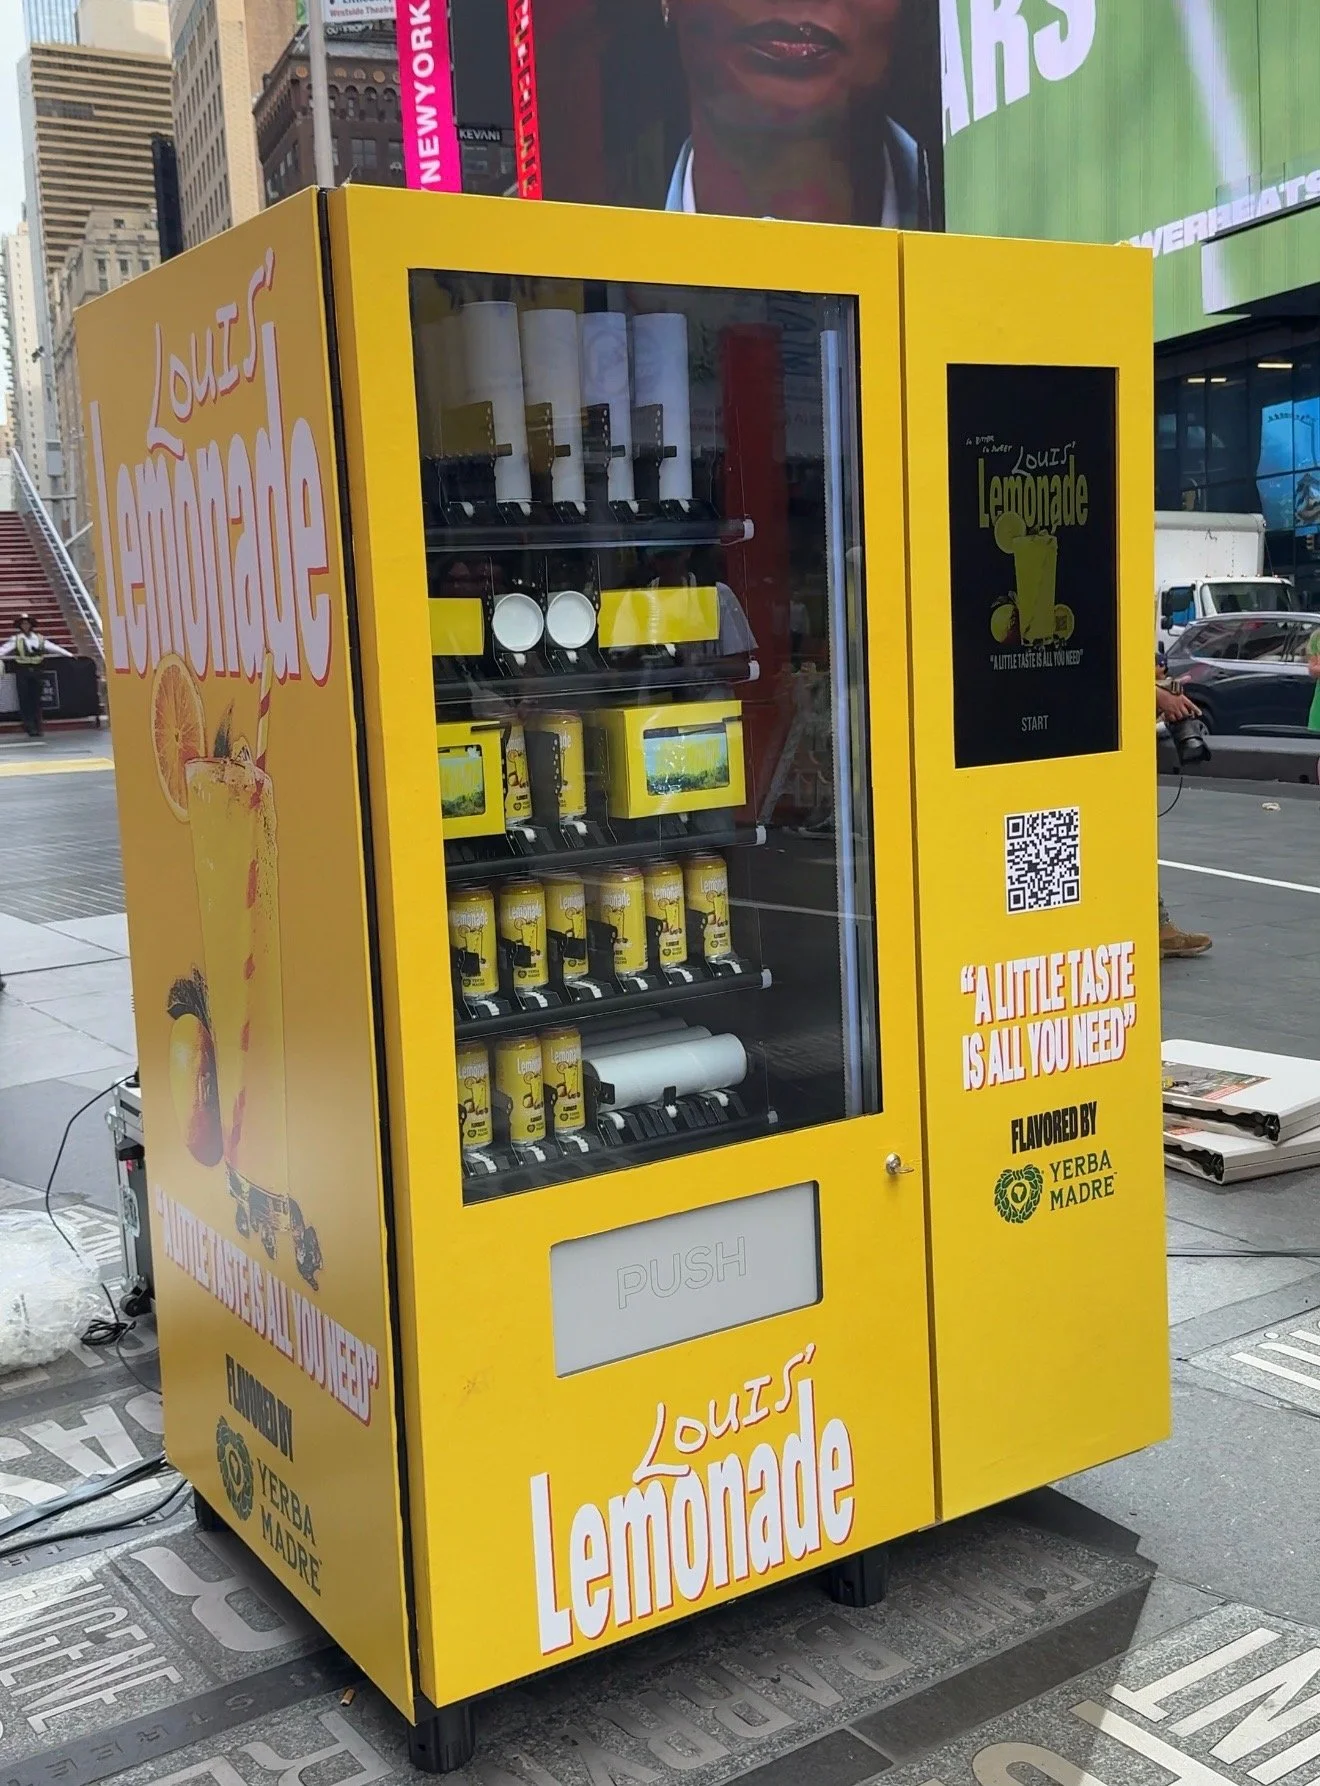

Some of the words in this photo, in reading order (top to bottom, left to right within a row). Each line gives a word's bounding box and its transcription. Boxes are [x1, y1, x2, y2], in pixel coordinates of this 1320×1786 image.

[90, 321, 332, 687] Lemonade
[977, 454, 1089, 529] Lemonade
[999, 653, 1018, 670] LITTLE
[1018, 651, 1036, 669] TASTE
[1036, 651, 1043, 668] IS
[1043, 650, 1053, 668] ALL
[1054, 650, 1066, 667] YOU
[1021, 715, 1049, 732] START
[994, 952, 1067, 1022] LITTLE
[1068, 940, 1136, 1008] TASTE
[962, 1032, 985, 1092] IS
[987, 1025, 1026, 1086] ALL
[1027, 1016, 1070, 1077] YOU
[1011, 1105, 1079, 1154] FLAVORED
[1079, 1100, 1098, 1139] BY
[1049, 1149, 1112, 1183] YERBA
[172, 1198, 211, 1293] LITTLE
[208, 1226, 251, 1328] TASTE
[250, 1257, 266, 1340] IS
[266, 1270, 294, 1363] ALL
[292, 1288, 327, 1389] YOU
[616, 1235, 747, 1310] PUSH
[225, 1352, 279, 1449] FLAVORED
[277, 1398, 294, 1463] BY
[257, 1457, 316, 1547] YERBA
[530, 1378, 856, 1657] Lemonade
